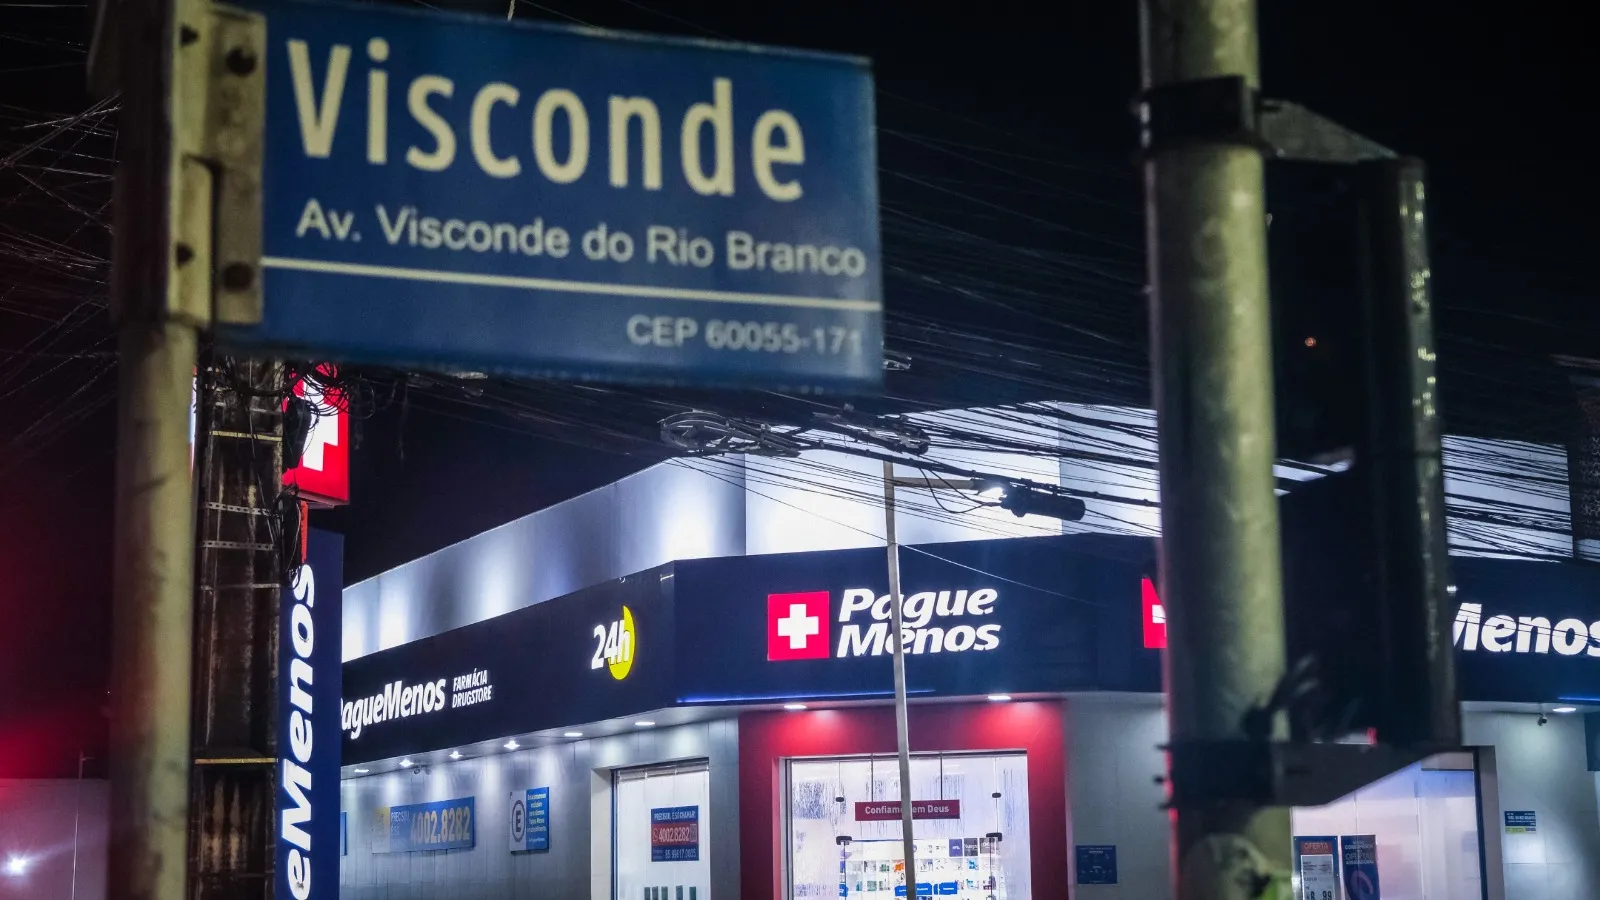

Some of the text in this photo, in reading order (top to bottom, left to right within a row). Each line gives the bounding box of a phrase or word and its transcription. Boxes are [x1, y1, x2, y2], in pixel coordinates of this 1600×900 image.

[287, 37, 806, 202] Visconde
[296, 198, 866, 278] Av. Visconde do Rio Branco
[626, 315, 864, 356] CEP 60055-171
[838, 588, 998, 628] Pague
[591, 619, 631, 669] 24h
[836, 623, 1001, 658] Menos
[452, 685, 493, 708] DRUGSTORE
[453, 668, 488, 692] FARMÁCIA
[341, 679, 446, 740] agueMenos
[865, 806, 902, 814] Confiam
[927, 804, 949, 813] Deus
